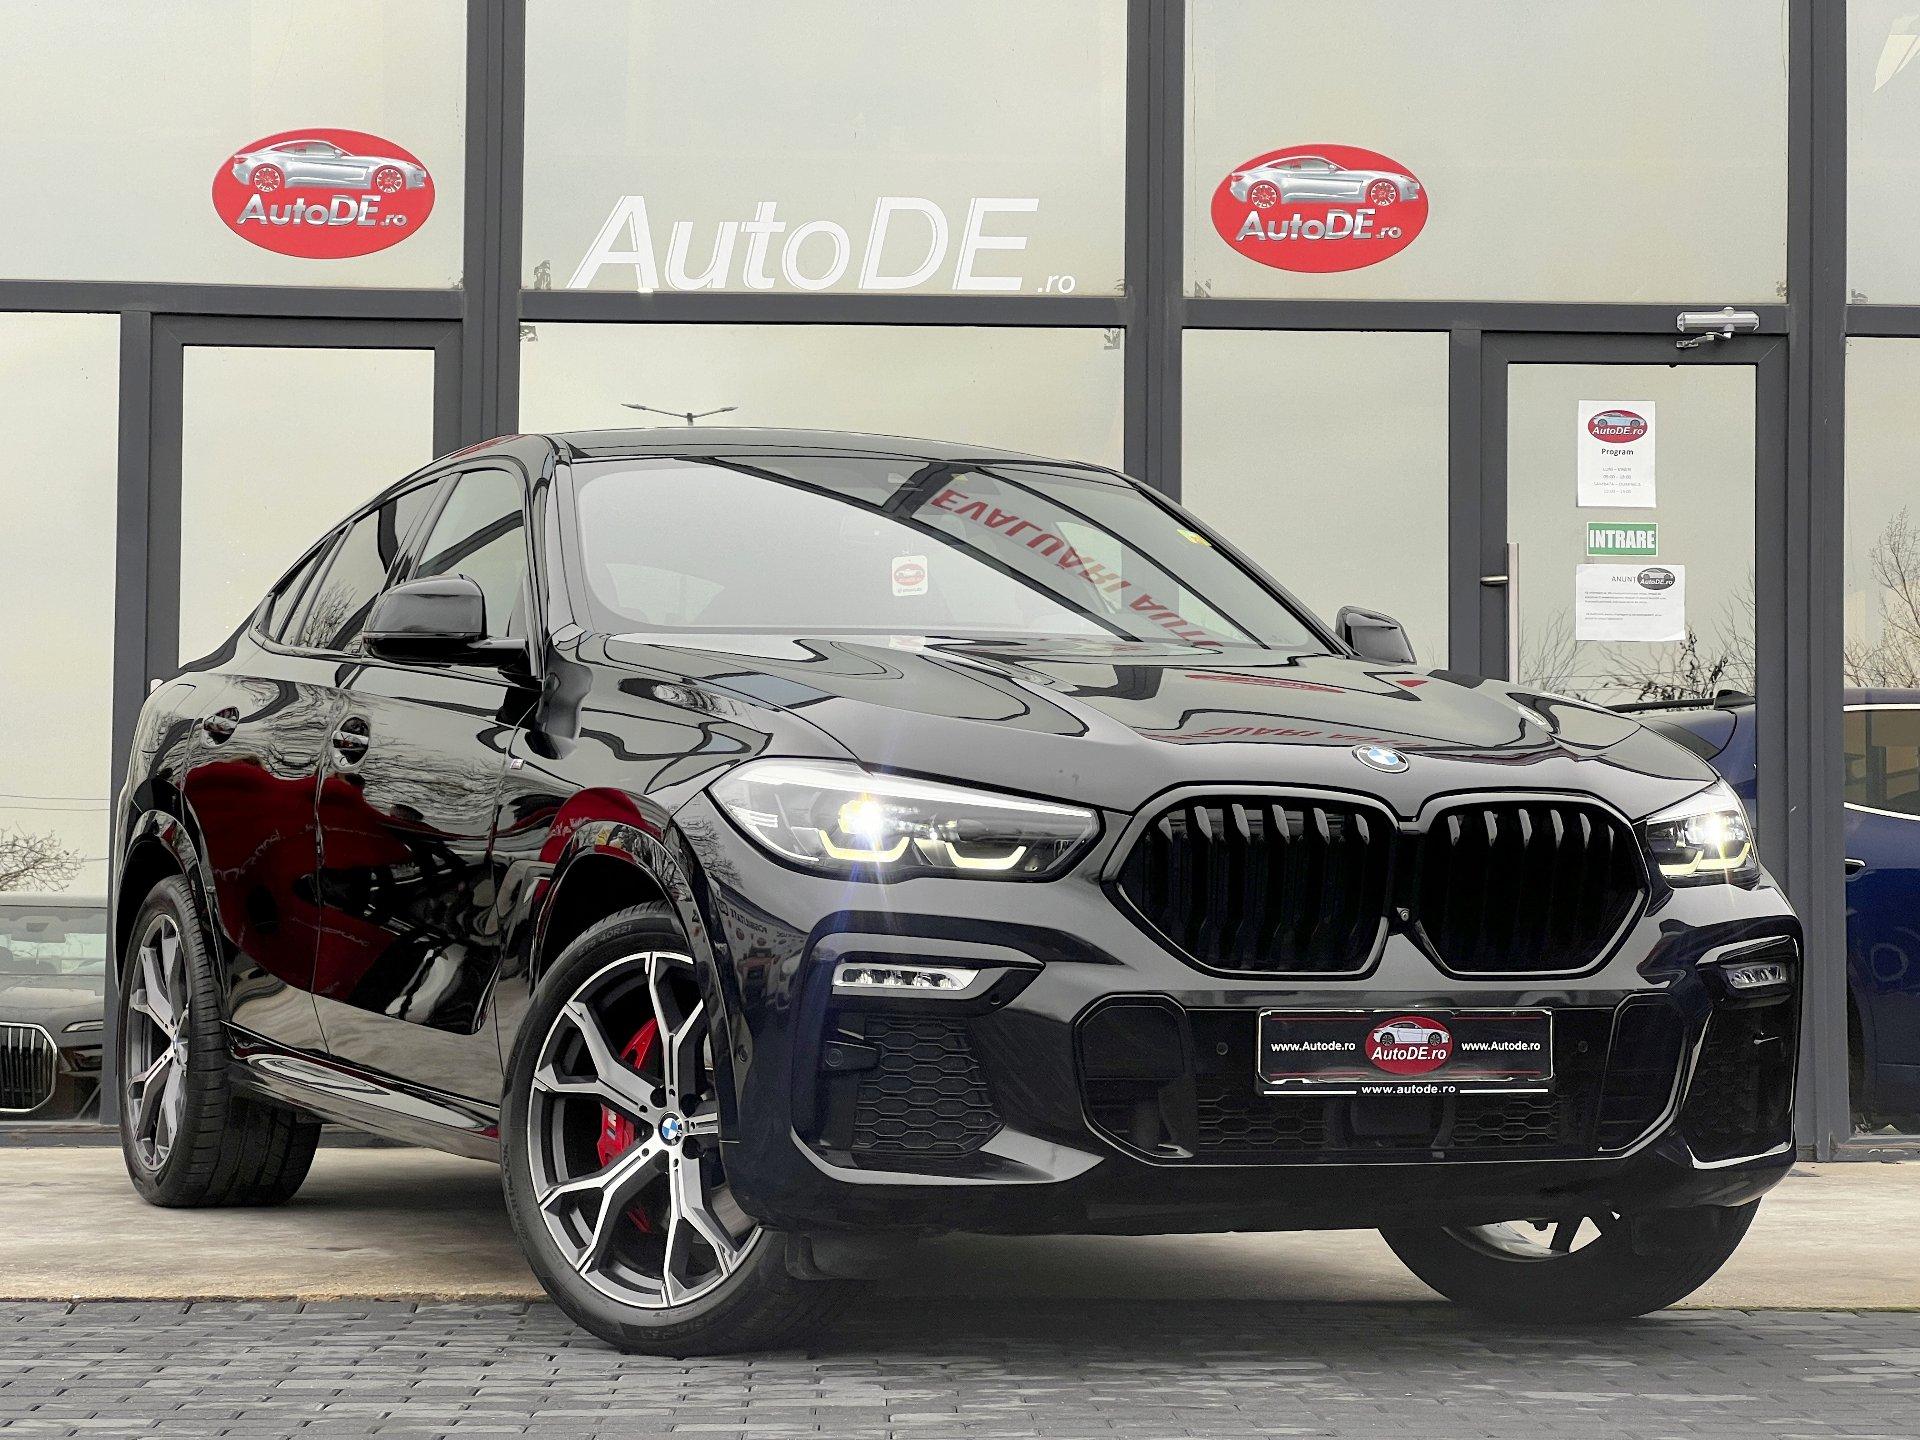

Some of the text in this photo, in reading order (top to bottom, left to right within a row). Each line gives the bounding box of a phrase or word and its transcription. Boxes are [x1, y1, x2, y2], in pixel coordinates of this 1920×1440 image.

[236, 194, 408, 227] AutoDE.ro
[1235, 208, 1402, 242] AutoDE.ro
[1592, 426, 1644, 436] AutoDE.ro
[1601, 448, 1634, 456] Program
[1589, 529, 1656, 549] INTRARE
[1271, 1041, 1356, 1052] www.Autode.ro
[1461, 1041, 1541, 1052] www.Autode.ro
[1371, 1046, 1447, 1061] AutoDE.ro
[1361, 1084, 1456, 1094] www.autode.ro
